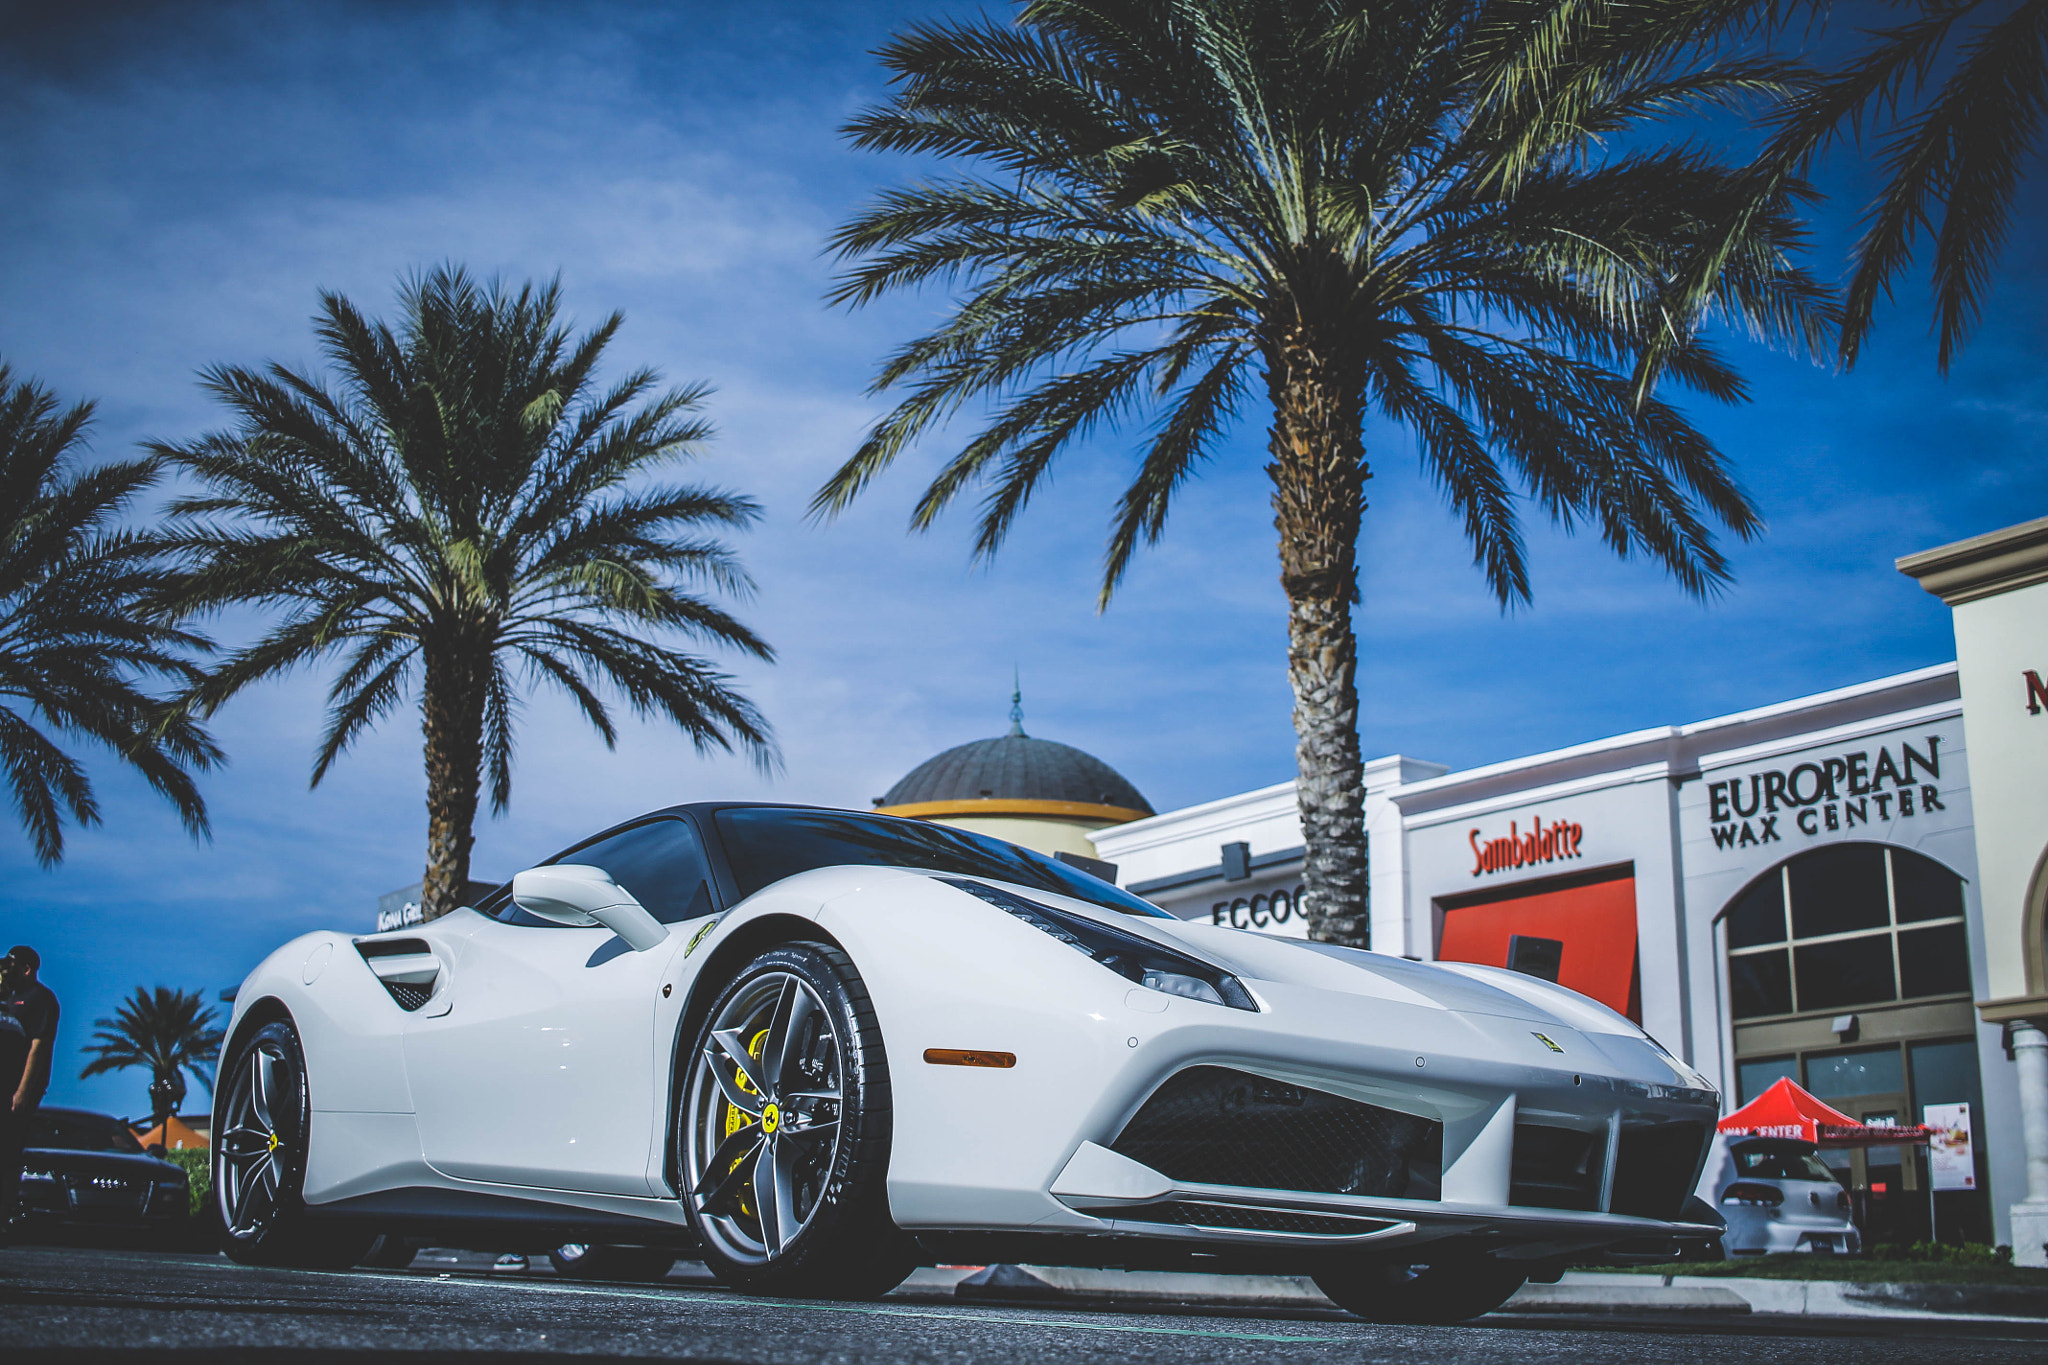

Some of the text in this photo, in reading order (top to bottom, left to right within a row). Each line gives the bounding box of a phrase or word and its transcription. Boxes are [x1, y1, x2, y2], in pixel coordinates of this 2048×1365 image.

[1707, 735, 1941, 823] EUROPEAN
[1469, 815, 1582, 876] Sambalatte
[1711, 784, 1945, 850] WAX CENTER
